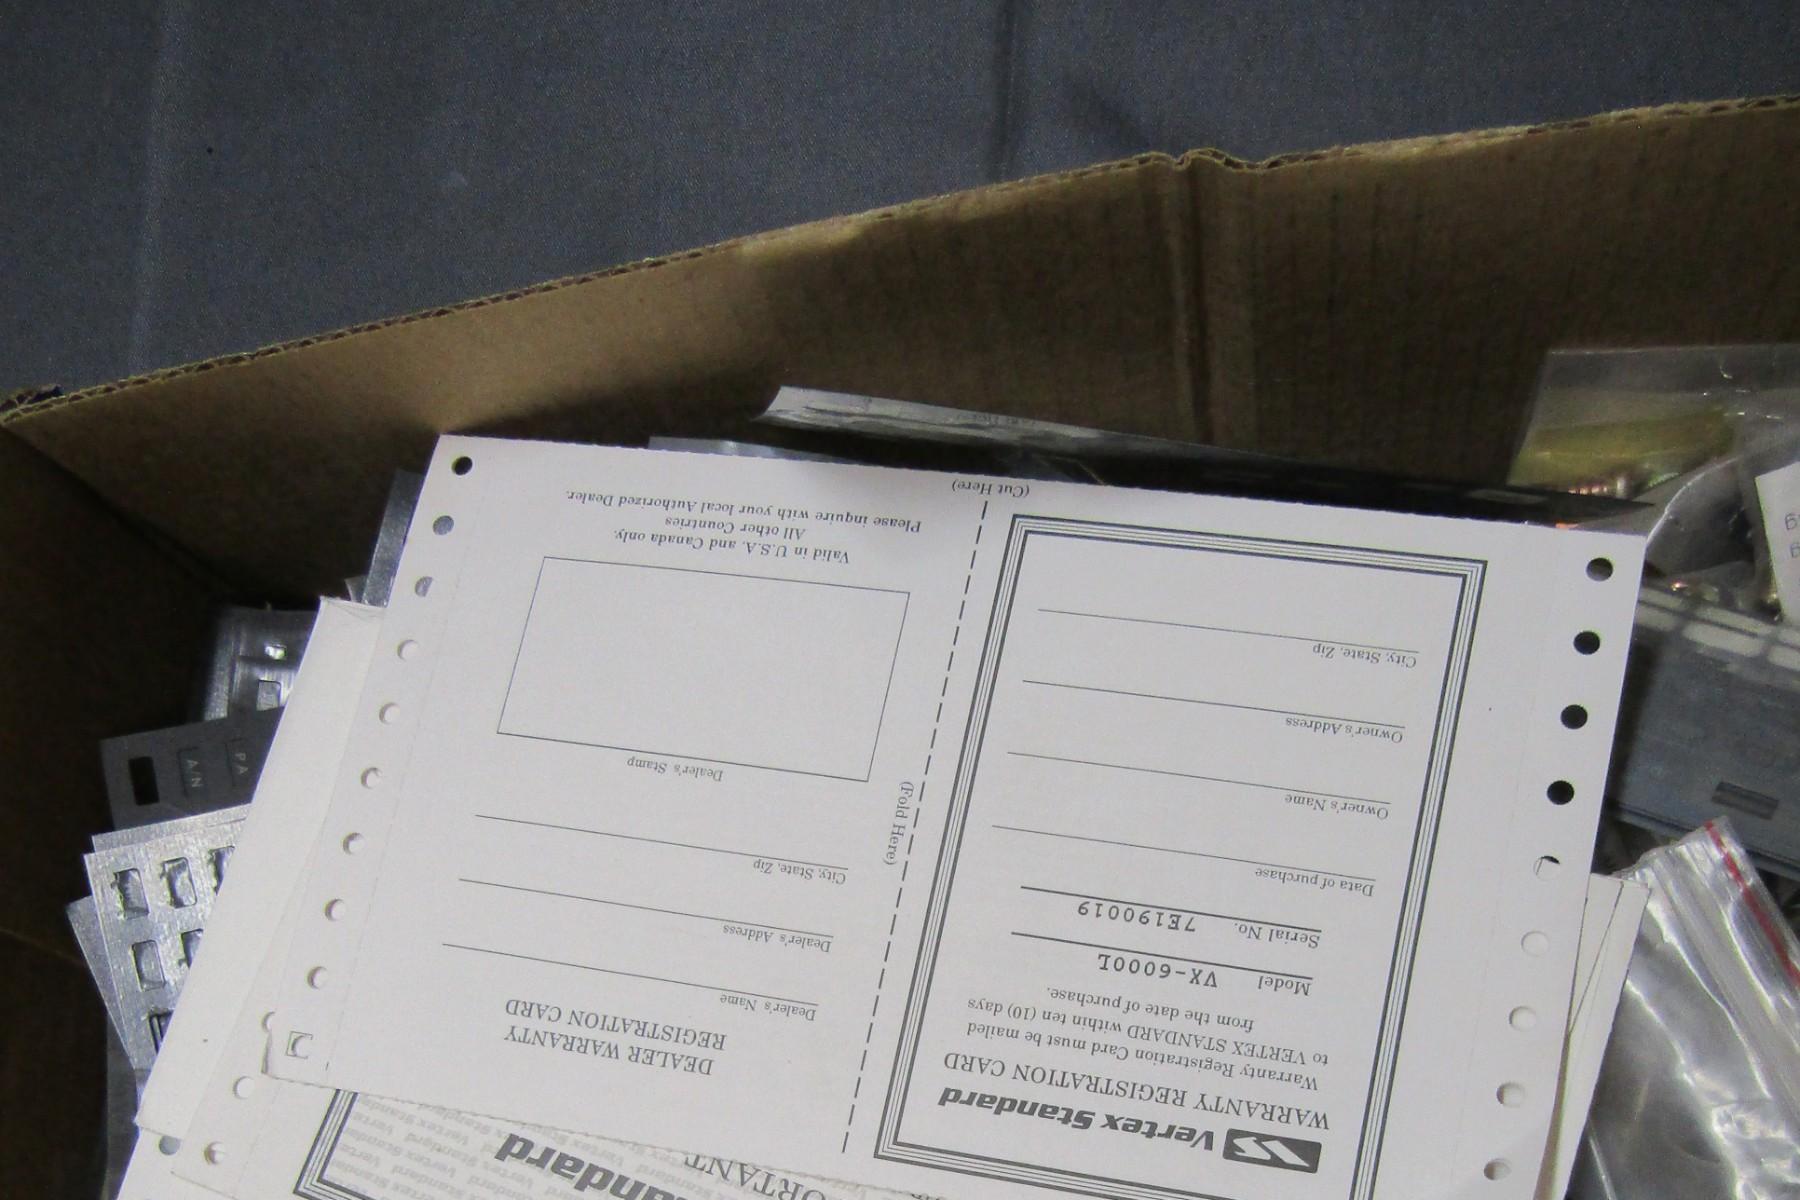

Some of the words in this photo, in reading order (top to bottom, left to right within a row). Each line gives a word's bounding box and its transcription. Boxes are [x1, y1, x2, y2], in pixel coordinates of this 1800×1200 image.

[951, 479, 992, 495] Here)
[997, 483, 1030, 497] (Cut
[566, 490, 614, 507] Dealer.
[617, 495, 697, 512] Authorized
[700, 501, 734, 516] local
[737, 504, 773, 515] your
[776, 507, 809, 520] with
[664, 516, 735, 534] Countries
[814, 510, 868, 528] inquire
[872, 515, 922, 533] Please
[613, 527, 646, 543] only.
[739, 523, 779, 537] other
[782, 526, 806, 540] All
[650, 532, 704, 549] Canada
[708, 537, 736, 551] and
[741, 540, 787, 557] U.S.A.
[793, 546, 808, 559] in
[812, 547, 849, 564] Valid
[1285, 716, 1343, 735] Address
[1344, 724, 1403, 743] Owner's
[626, 755, 667, 773] Stamp
[673, 764, 723, 782] Dealer's
[894, 780, 914, 819] (Fold
[1284, 793, 1326, 811] Name
[1330, 800, 1389, 819] Owner's
[883, 823, 906, 865] Here)
[1254, 867, 1319, 885] purchase
[1319, 877, 1335, 890] of
[1339, 879, 1374, 897] Data
[1076, 900, 1196, 932] 7E190019
[722, 924, 774, 943] Address
[1233, 922, 1263, 940] No.
[1267, 928, 1320, 949] Serial
[779, 933, 832, 953] Dealer's
[1097, 952, 1218, 988] VX-6000L
[1257, 975, 1311, 996] Model
[719, 993, 757, 1011] Name
[1046, 987, 1122, 1008] purchase.
[504, 998, 562, 1022] CARD
[763, 1001, 816, 1021] Dealer's
[967, 999, 1003, 1016] days
[1006, 1002, 1036, 1021] (10)
[1121, 1000, 1140, 1014] of
[1144, 1003, 1179, 1021] date
[1041, 1009, 1066, 1025] ten
[1071, 1014, 1121, 1034] within
[1183, 1009, 1210, 1026] the
[1216, 1014, 1254, 1033] from
[566, 1009, 727, 1051] REGISTRATION
[966, 1021, 1020, 1039] mailed
[1023, 1030, 1042, 1047] be
[1126, 1024, 1227, 1053] STANDARD
[503, 1024, 619, 1060] WARRANTY
[1046, 1034, 1086, 1050] must
[1090, 1041, 1129, 1061] Card
[627, 1044, 714, 1075] DEALER
[1230, 1040, 1306, 1065] VERTEX
[1312, 1052, 1328, 1066] to
[943, 1052, 1005, 1077] CARD
[1134, 1048, 1235, 1078] Registration
[1010, 1063, 1188, 1107] REGISTRATION
[1239, 1062, 1318, 1091] Warranty
[936, 1086, 1096, 1130] Standard
[1192, 1092, 1330, 1130] WARRANTY
[1099, 1113, 1214, 1151] Vertex
